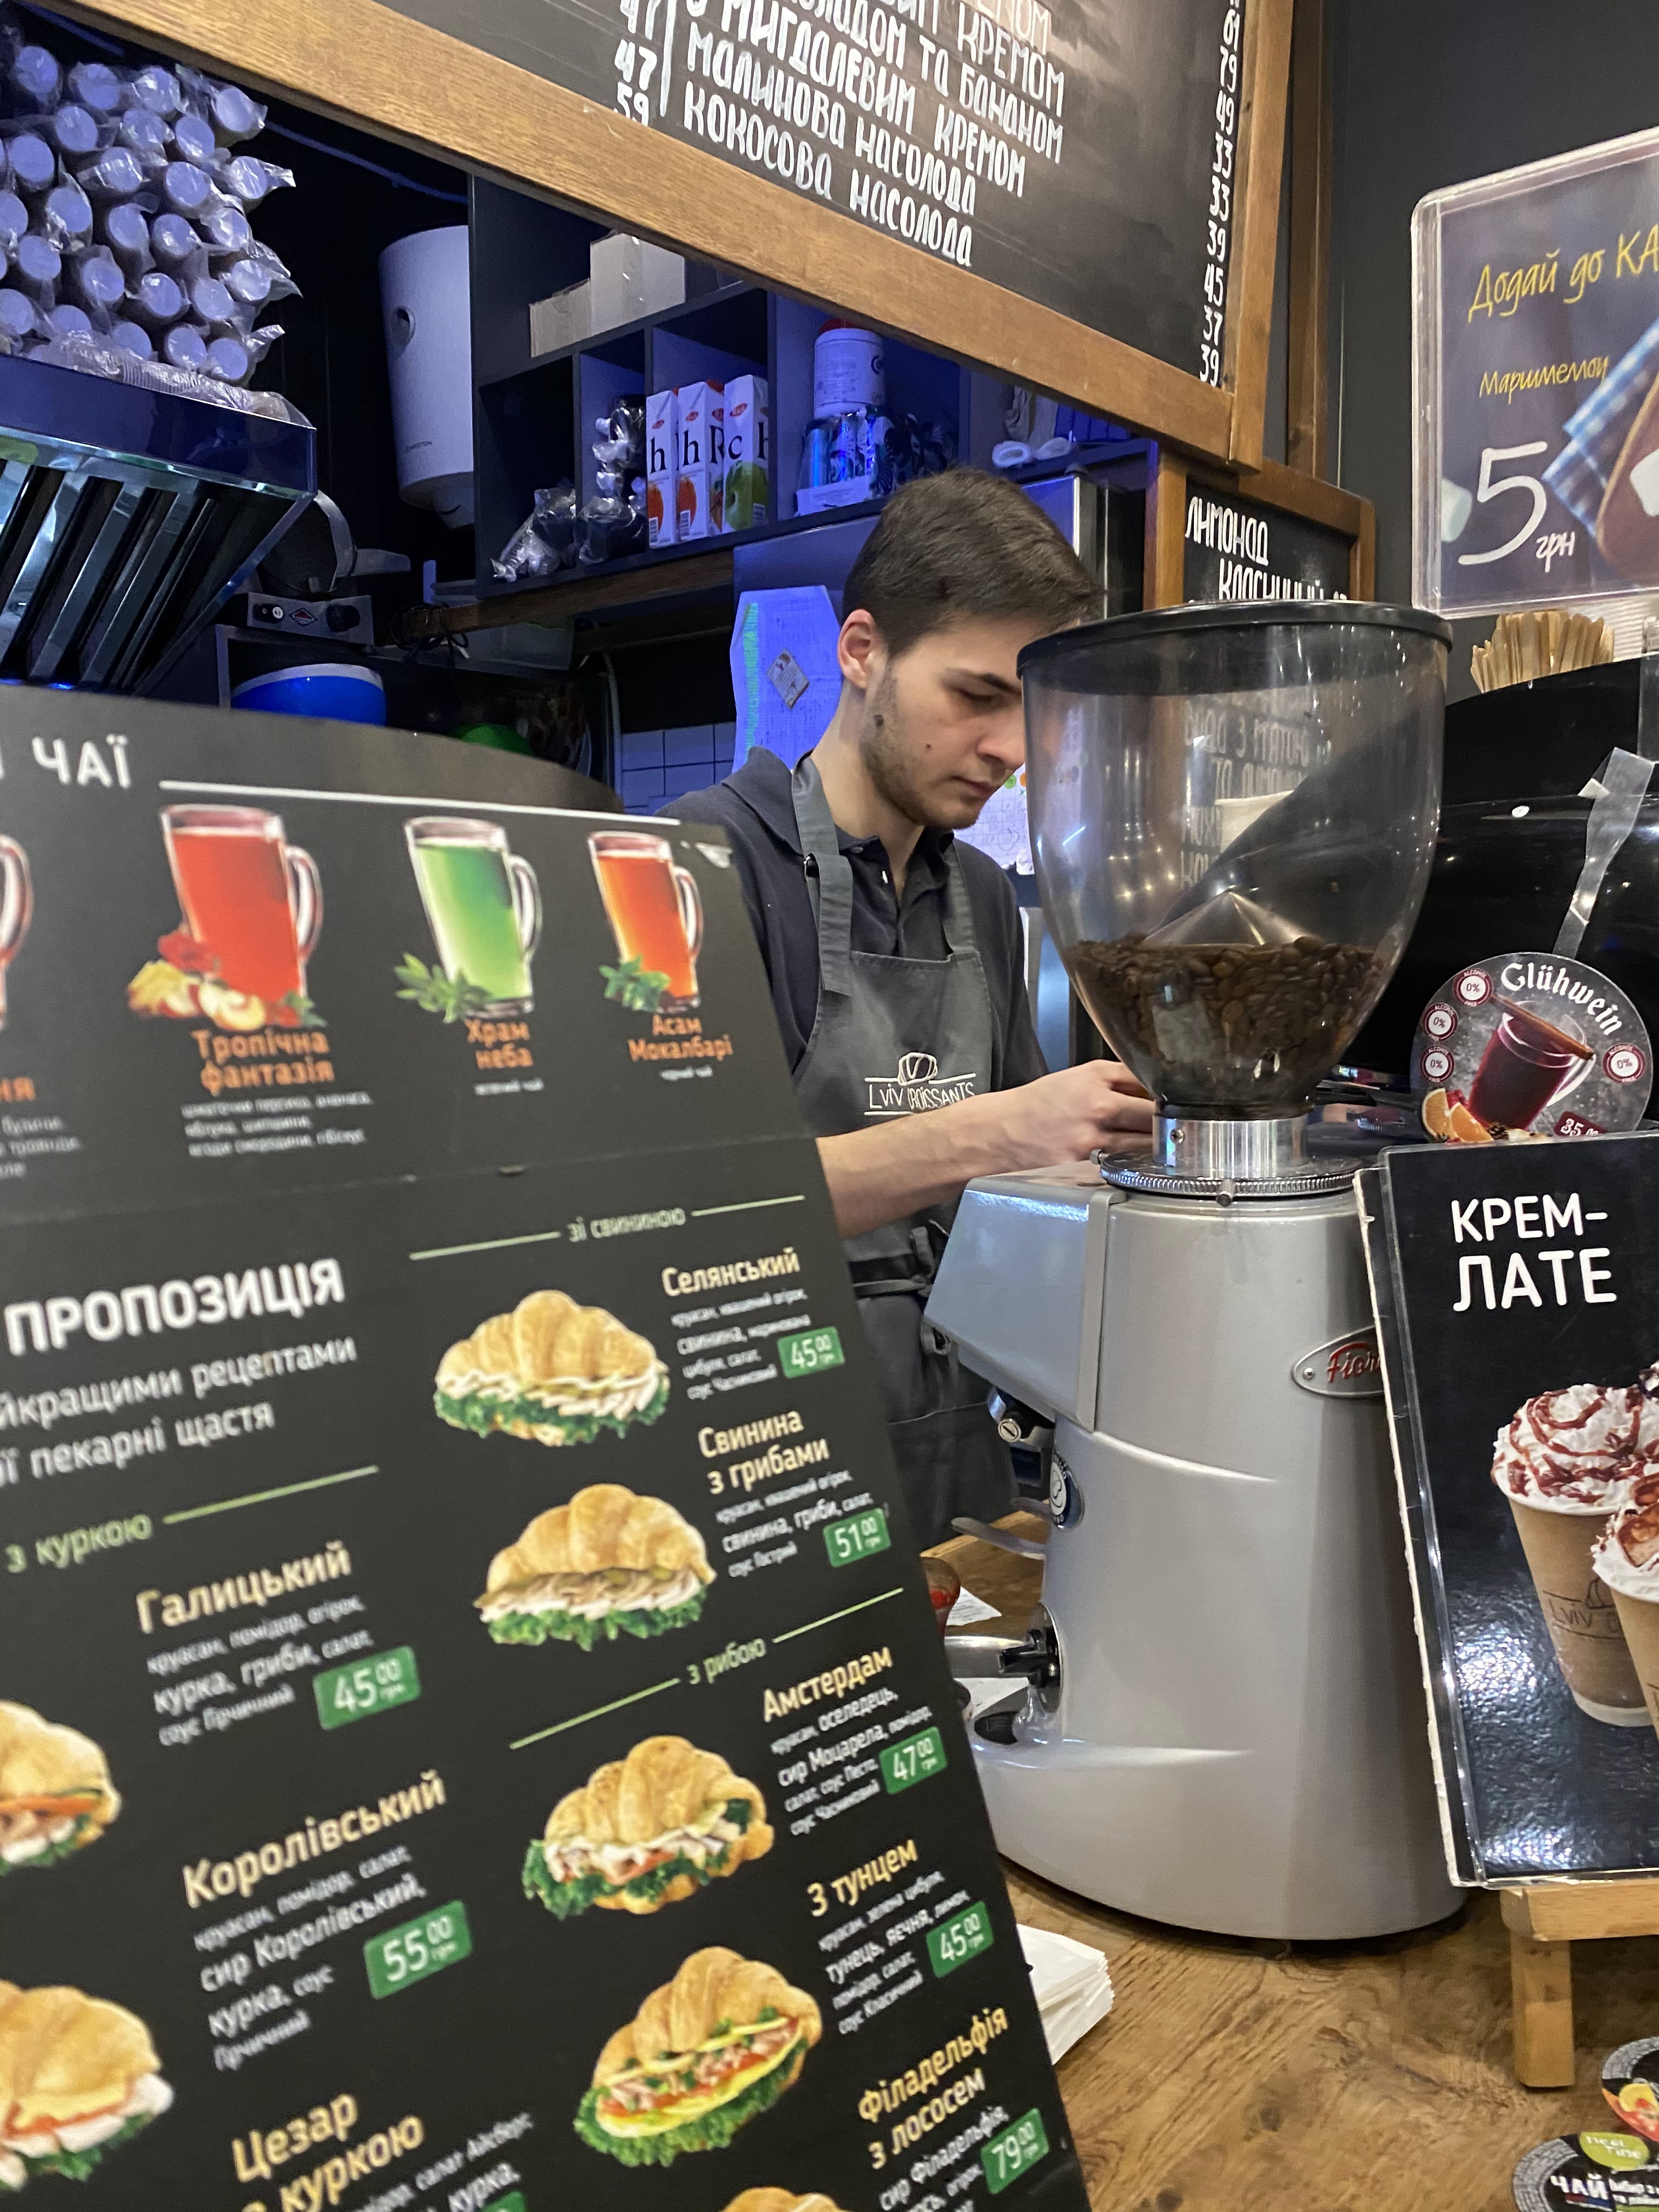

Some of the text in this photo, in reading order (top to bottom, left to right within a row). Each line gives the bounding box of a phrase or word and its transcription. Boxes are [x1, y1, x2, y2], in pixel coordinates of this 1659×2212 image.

[614, 39, 657, 91] 47
[957, 2, 1064, 117] КРЕМОМ
[1220, 44, 1237, 93] 79
[614, 81, 650, 127] 59
[687, 21, 975, 216] МАЛИНОВА НАСОЛОДА
[919, 35, 949, 97] ТА
[959, 62, 1063, 163] БАНАНОМ
[1216, 89, 1234, 135] 49
[684, 81, 972, 267] КОКОСОВА НАСОЛОДА
[934, 103, 1025, 198] КРЕМОМ
[1212, 132, 1233, 179] 33
[1209, 175, 1230, 221] 33
[1207, 219, 1226, 263] 39
[1204, 263, 1224, 307] 45
[1468, 249, 1561, 324] Додай
[1563, 249, 1606, 304] до
[1203, 305, 1223, 346] 37
[1199, 343, 1220, 387] 39
[1185, 496, 1269, 567] ЛИМОНАД
[1458, 441, 1576, 573] 5 грн
[31, 734, 132, 789] ЧАЇ
[1466, 983, 1480, 993] 0%
[1501, 961, 1623, 1036] Glühwein
[190, 1028, 330, 1065] Тропічна
[1433, 1017, 1446, 1029] 0%
[1430, 1059, 1443, 1069] 0%
[1616, 1058, 1633, 1070] 0%
[1450, 1192, 1609, 1244] КРЕМ-
[662, 1246, 800, 1296] Селянський
[1452, 1247, 1618, 1313] ЛАТЕ
[4, 1257, 346, 1357] ПРОПОЗИЦІЯ
[190, 1336, 357, 1399] рецептами
[30, 1417, 166, 1479] пекарні
[174, 1401, 275, 1447] щастя
[698, 1410, 805, 1459] Свинина
[729, 1438, 830, 1492] грибами
[36, 1513, 153, 1568] куркою
[136, 1540, 352, 1633] Галицький
[703, 1637, 766, 1684] рибою
[763, 1646, 894, 1723] Амстердам
[182, 1769, 447, 1909] Королівський
[830, 1838, 919, 1906] тунцем
[858, 2007, 1009, 2123] Філадельфія
[232, 2092, 358, 2183] Цезар
[891, 2067, 986, 2156] лососем
[279, 2115, 425, 2212] куркою
[1550, 2172, 1609, 2201] ЧАЙ
